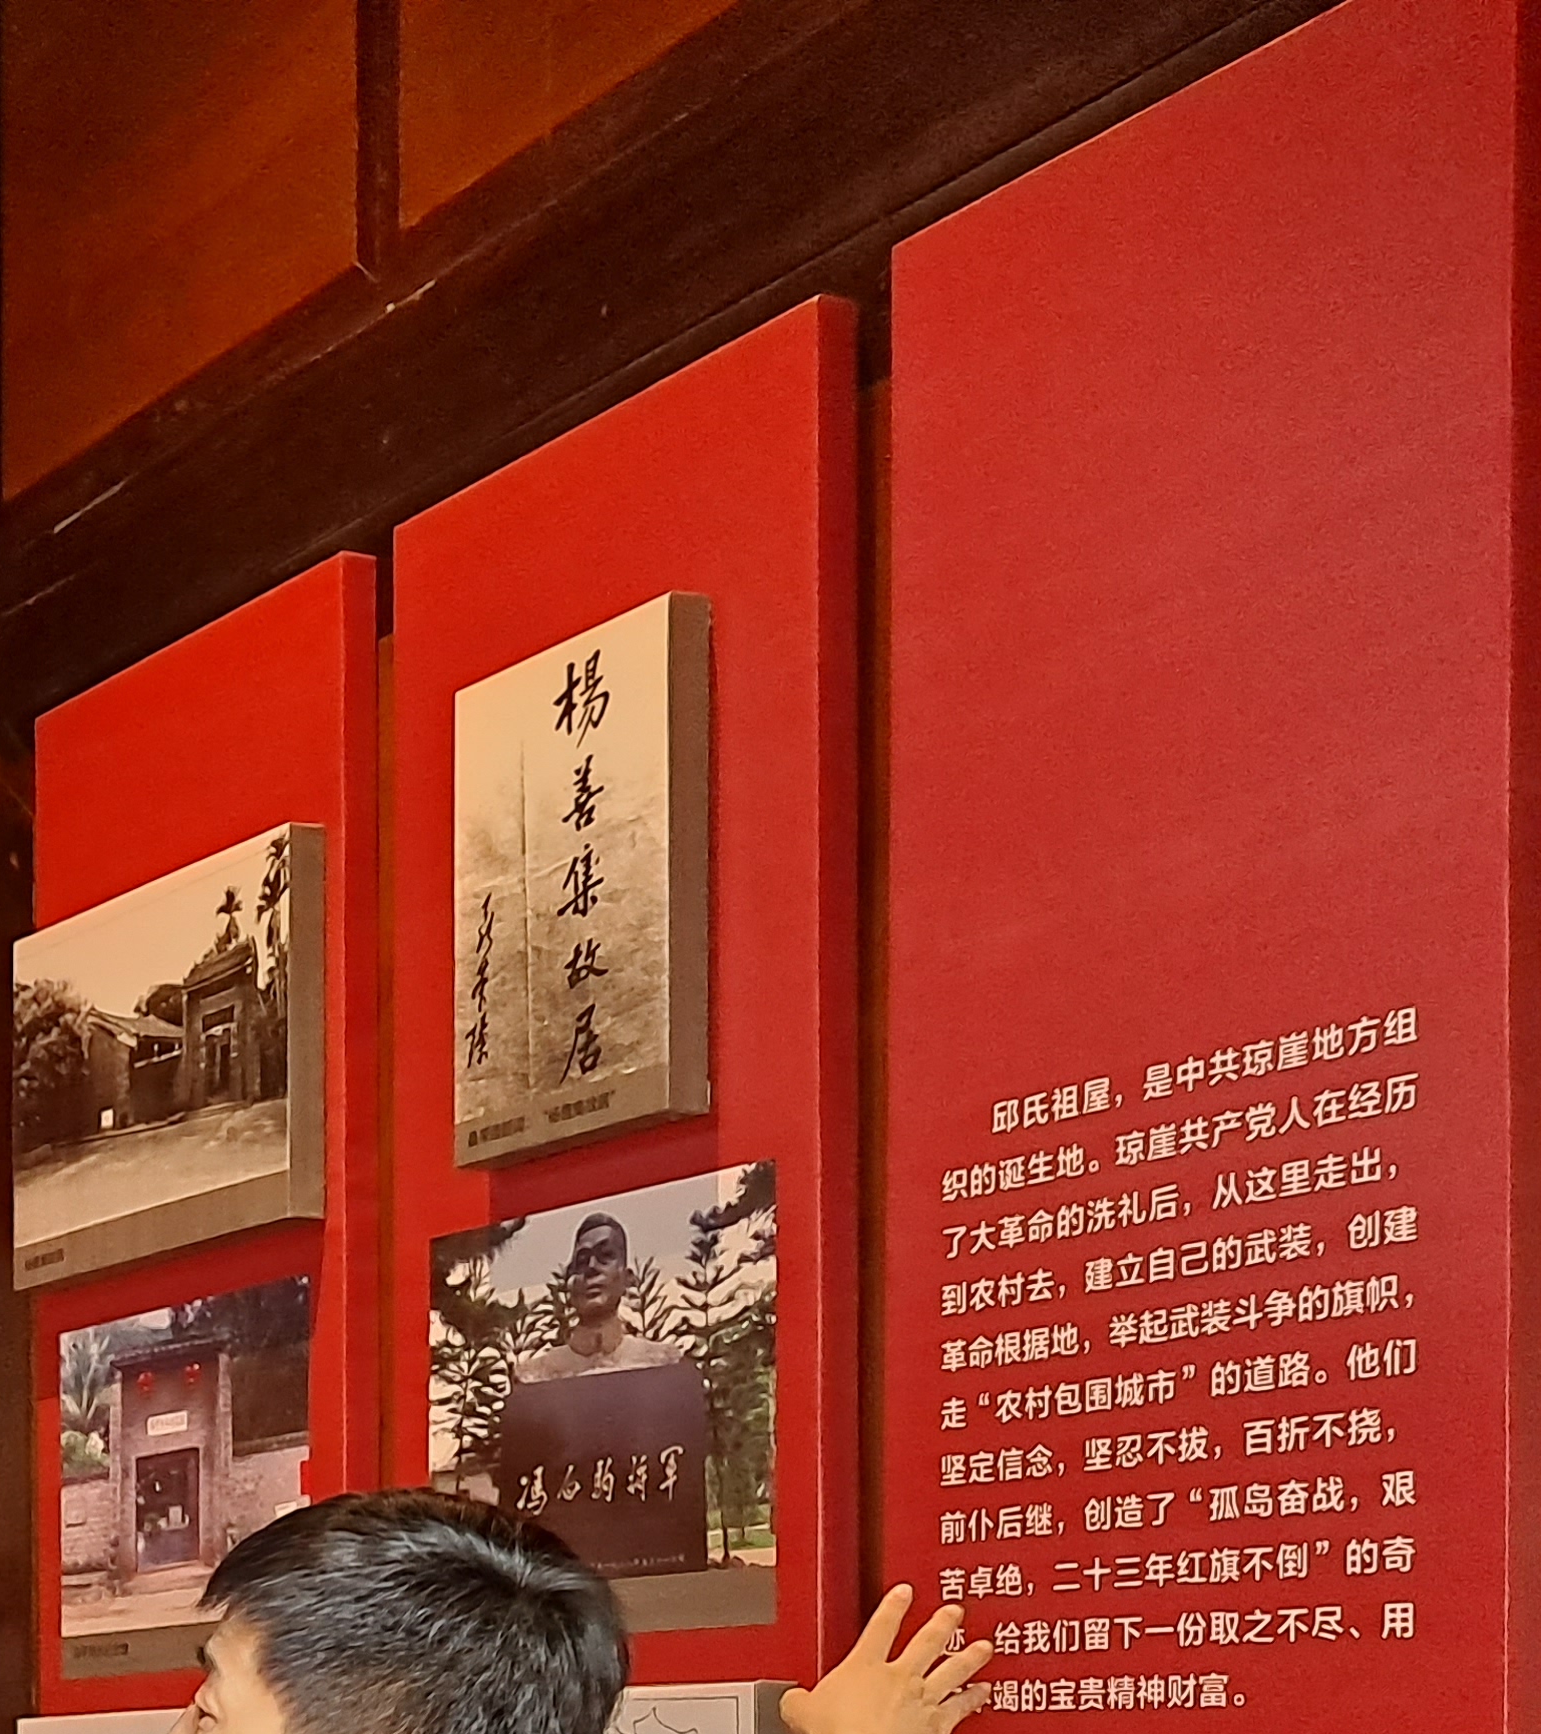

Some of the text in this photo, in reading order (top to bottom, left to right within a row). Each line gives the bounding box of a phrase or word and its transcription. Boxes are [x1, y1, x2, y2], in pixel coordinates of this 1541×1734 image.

[990, 1006, 1419, 1134] 邱氏祖屋，是中共琼崖地方组
[940, 1071, 1420, 1203] 织的诞生地。琼崖共产党人在经历
[941, 1146, 1399, 1260] 了大革命的洗礼后，从这里走出，
[940, 1206, 1419, 1317] 到农村去，建立自己的武装，创建
[940, 1273, 1415, 1373] 革命根据地，举起武装斗争的旗帜，
[940, 1338, 1418, 1431] 走“农村包围城市”的道路。他们
[939, 1406, 1397, 1487] 坚定信念，坚忍不拔，百折不挠，
[939, 1469, 1417, 1546] 前仆后继，创造了“孤岛奋战，艰
[938, 1535, 1417, 1602] 苦卓绝，二十三年红旗不倒”的奇
